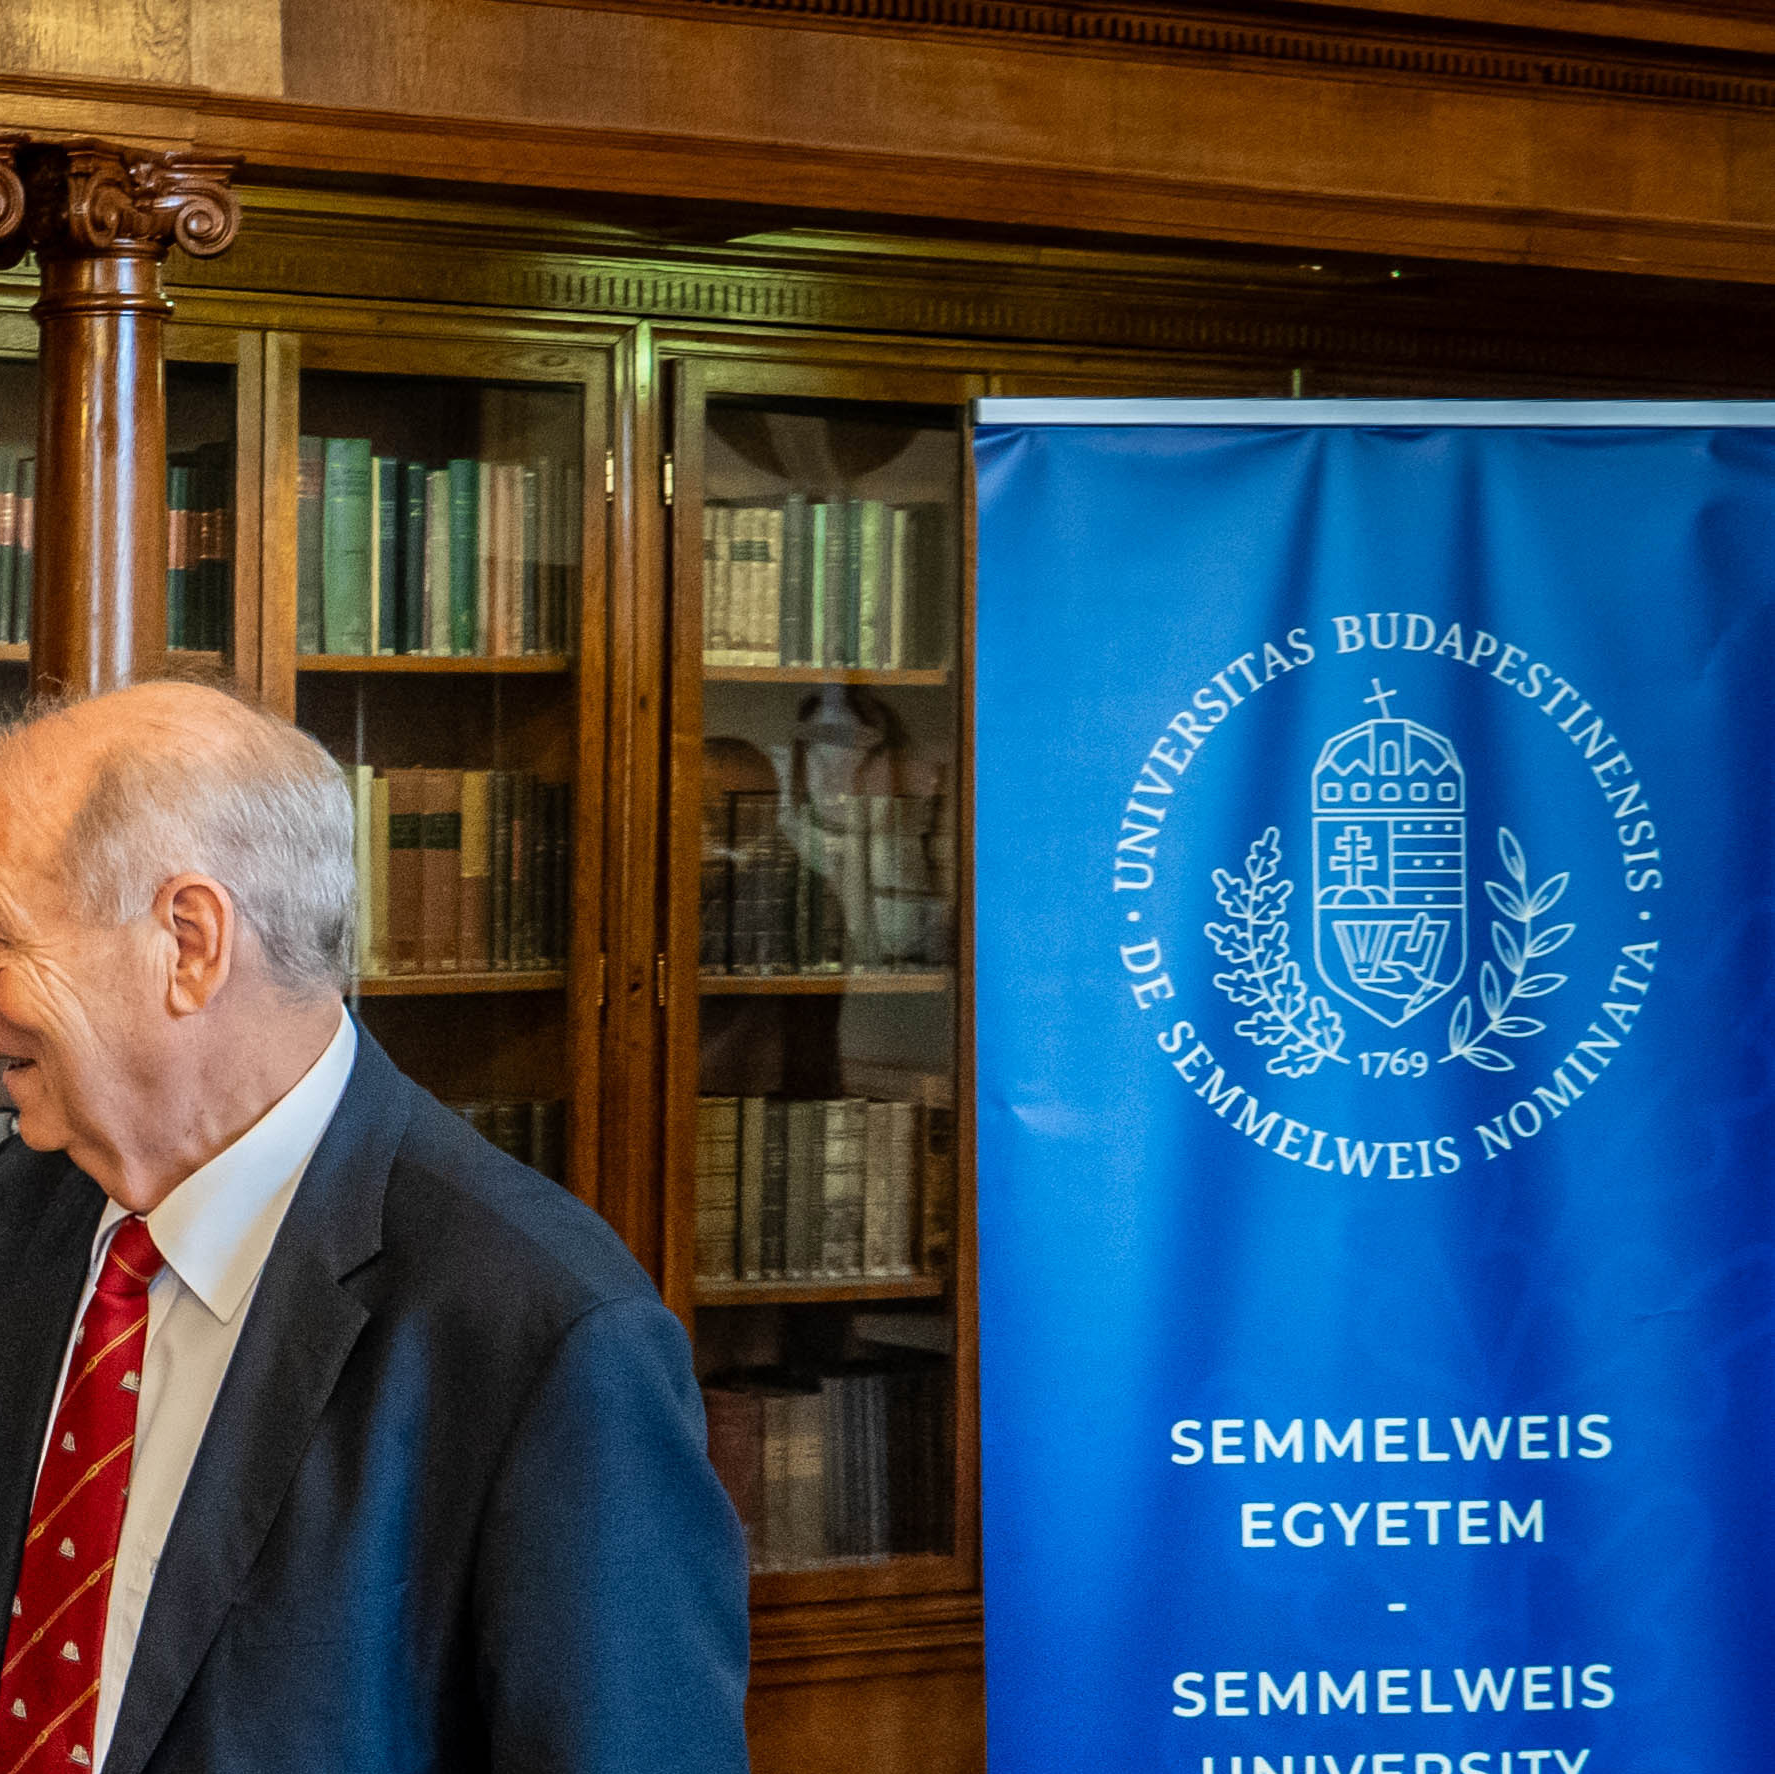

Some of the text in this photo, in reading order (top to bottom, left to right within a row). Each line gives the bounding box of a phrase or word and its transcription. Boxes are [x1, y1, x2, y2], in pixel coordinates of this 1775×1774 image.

[1114, 626, 1318, 893] UNIVERSITAS
[1331, 611, 1664, 893] BUDAPESTINENSIS
[1120, 938, 1175, 1010] DE
[1358, 1048, 1430, 1079] 1769
[1475, 940, 1659, 1160] NOMINATA
[1157, 1020, 1461, 1180] SEMMELWEIS
[1170, 1414, 1614, 1465] SEMMELWEIS
[1239, 1499, 1545, 1548] EGYETEM
[1171, 1664, 1615, 1717] SEMMELWEIS
